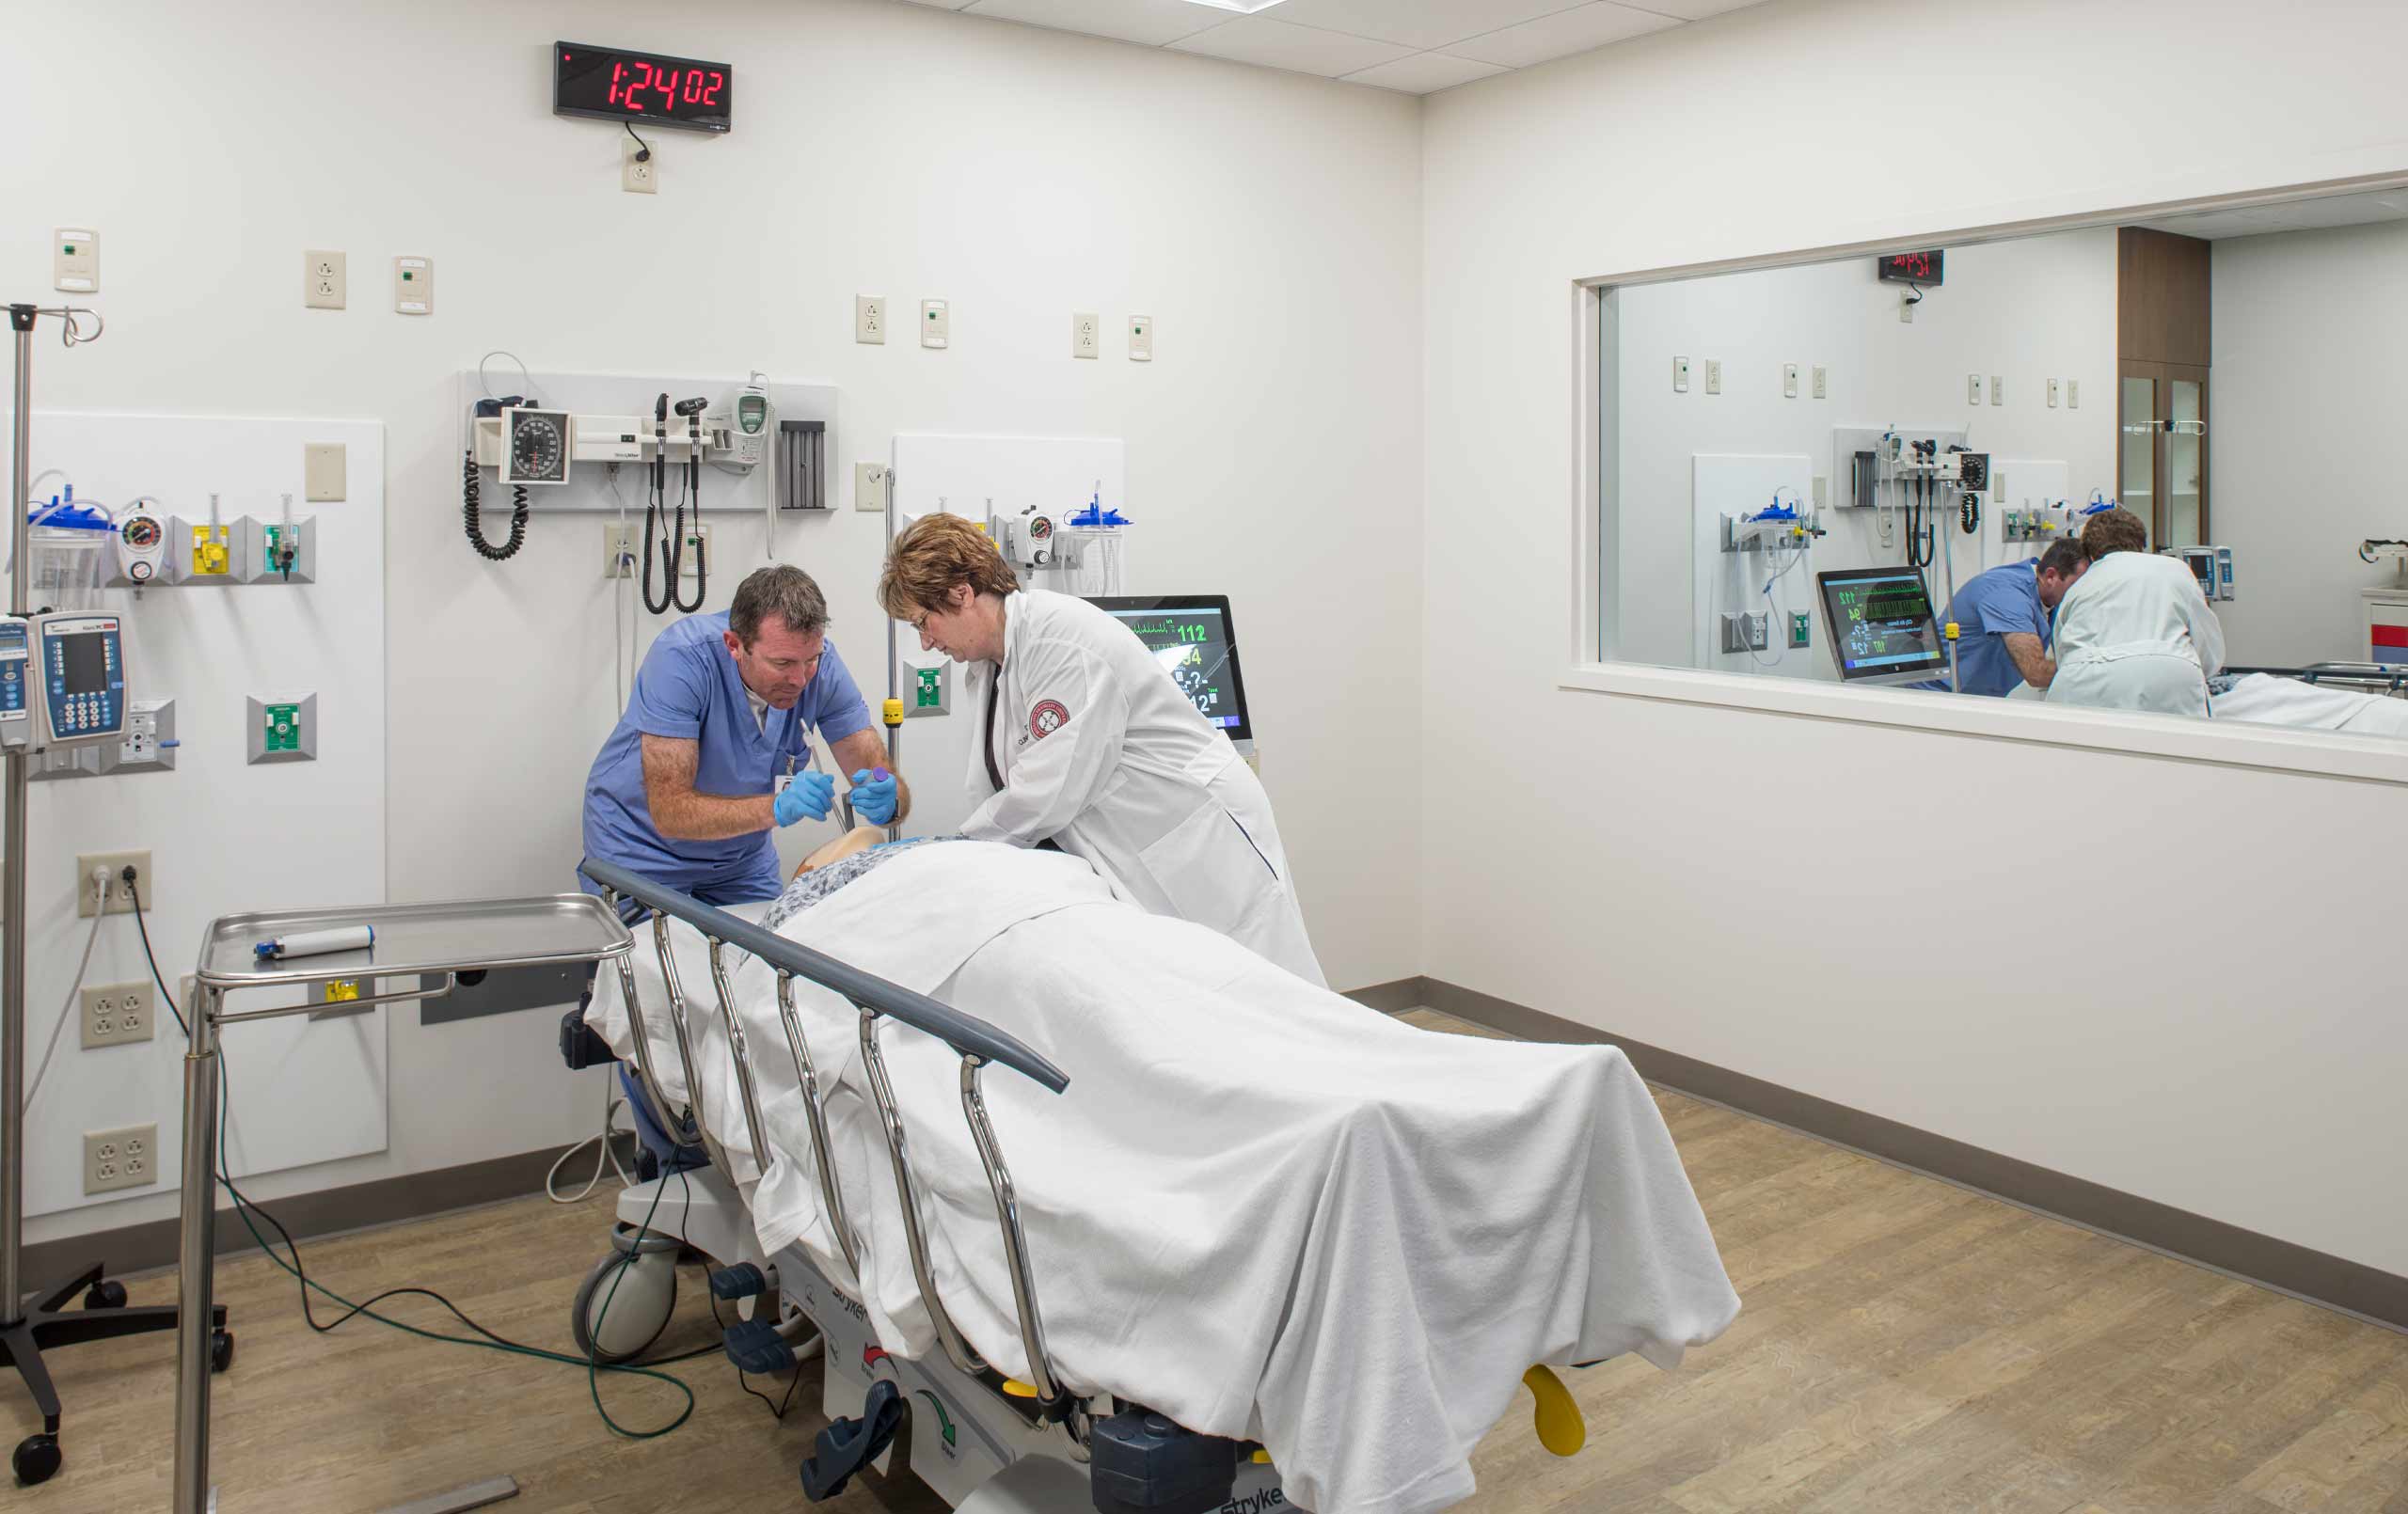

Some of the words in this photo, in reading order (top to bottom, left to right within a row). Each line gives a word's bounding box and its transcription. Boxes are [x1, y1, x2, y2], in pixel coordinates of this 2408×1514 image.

[609, 62, 678, 111] 1:24
[684, 70, 723, 105] 02
[1178, 624, 1206, 641] 112
